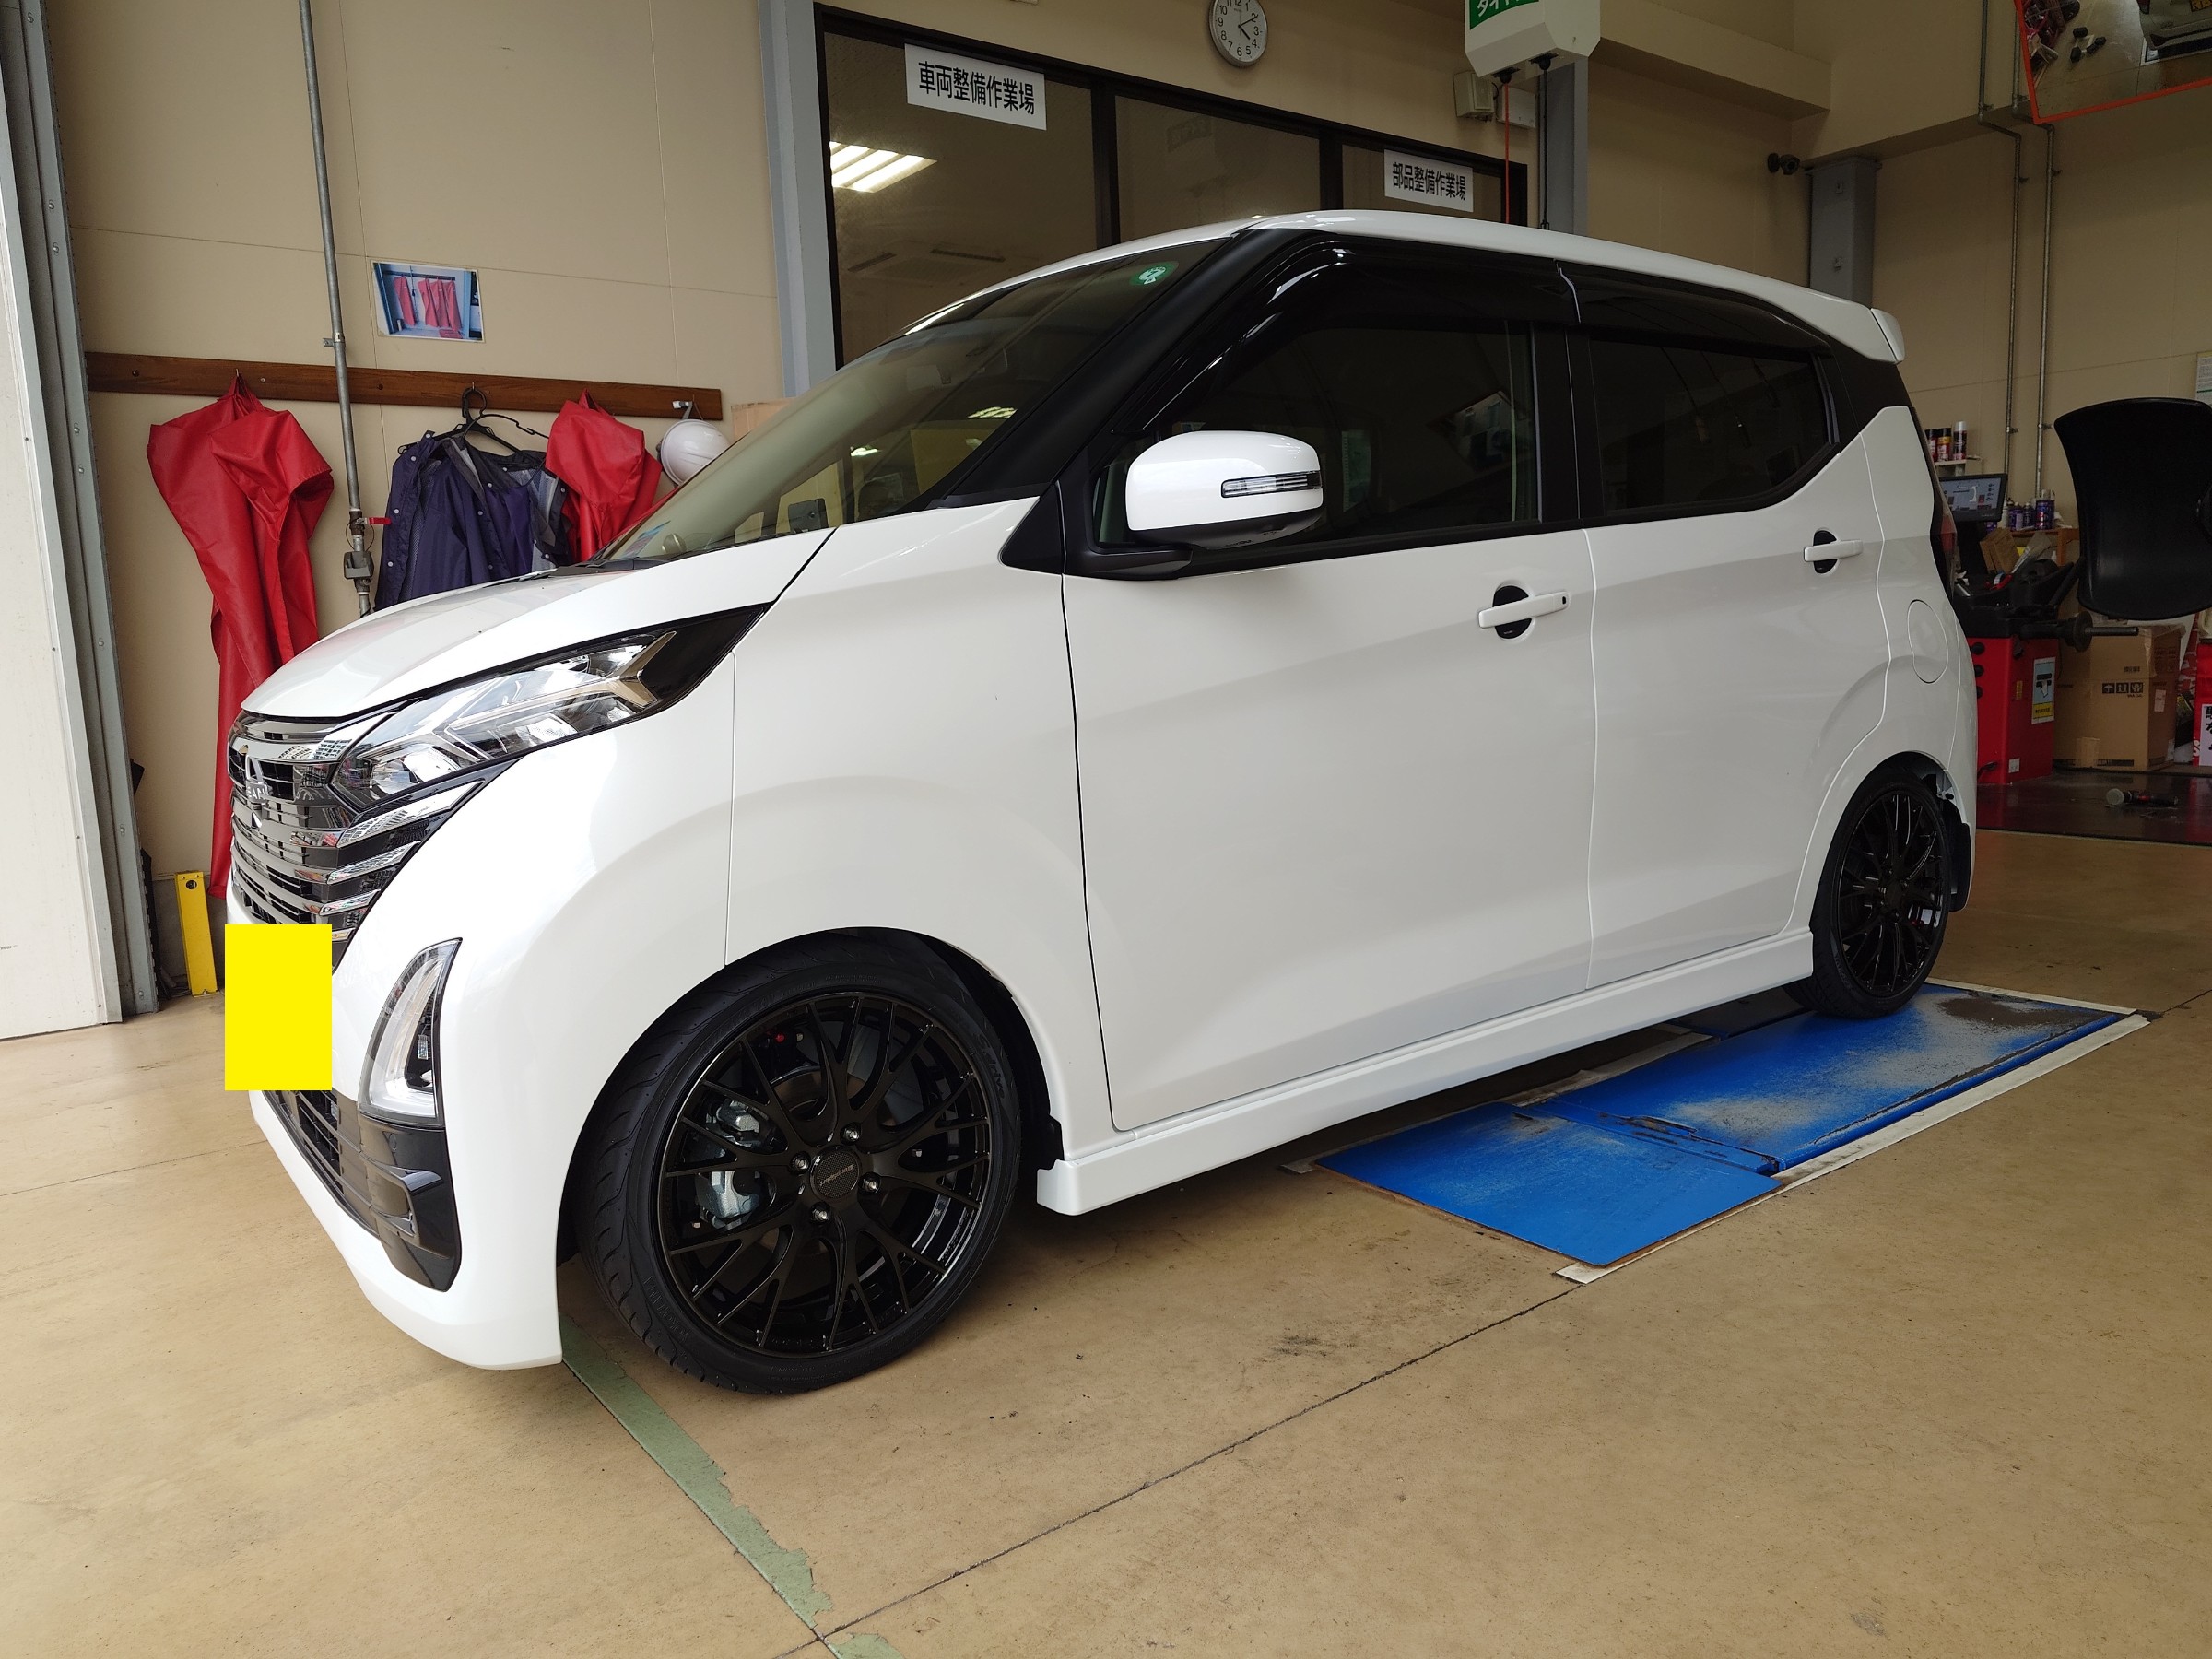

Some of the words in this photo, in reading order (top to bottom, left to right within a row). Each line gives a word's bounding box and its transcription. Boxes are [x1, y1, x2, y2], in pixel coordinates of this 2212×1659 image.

[918, 60, 1035, 116] 車両整備作業場
[1392, 161, 1466, 201] 部品整備作業場
